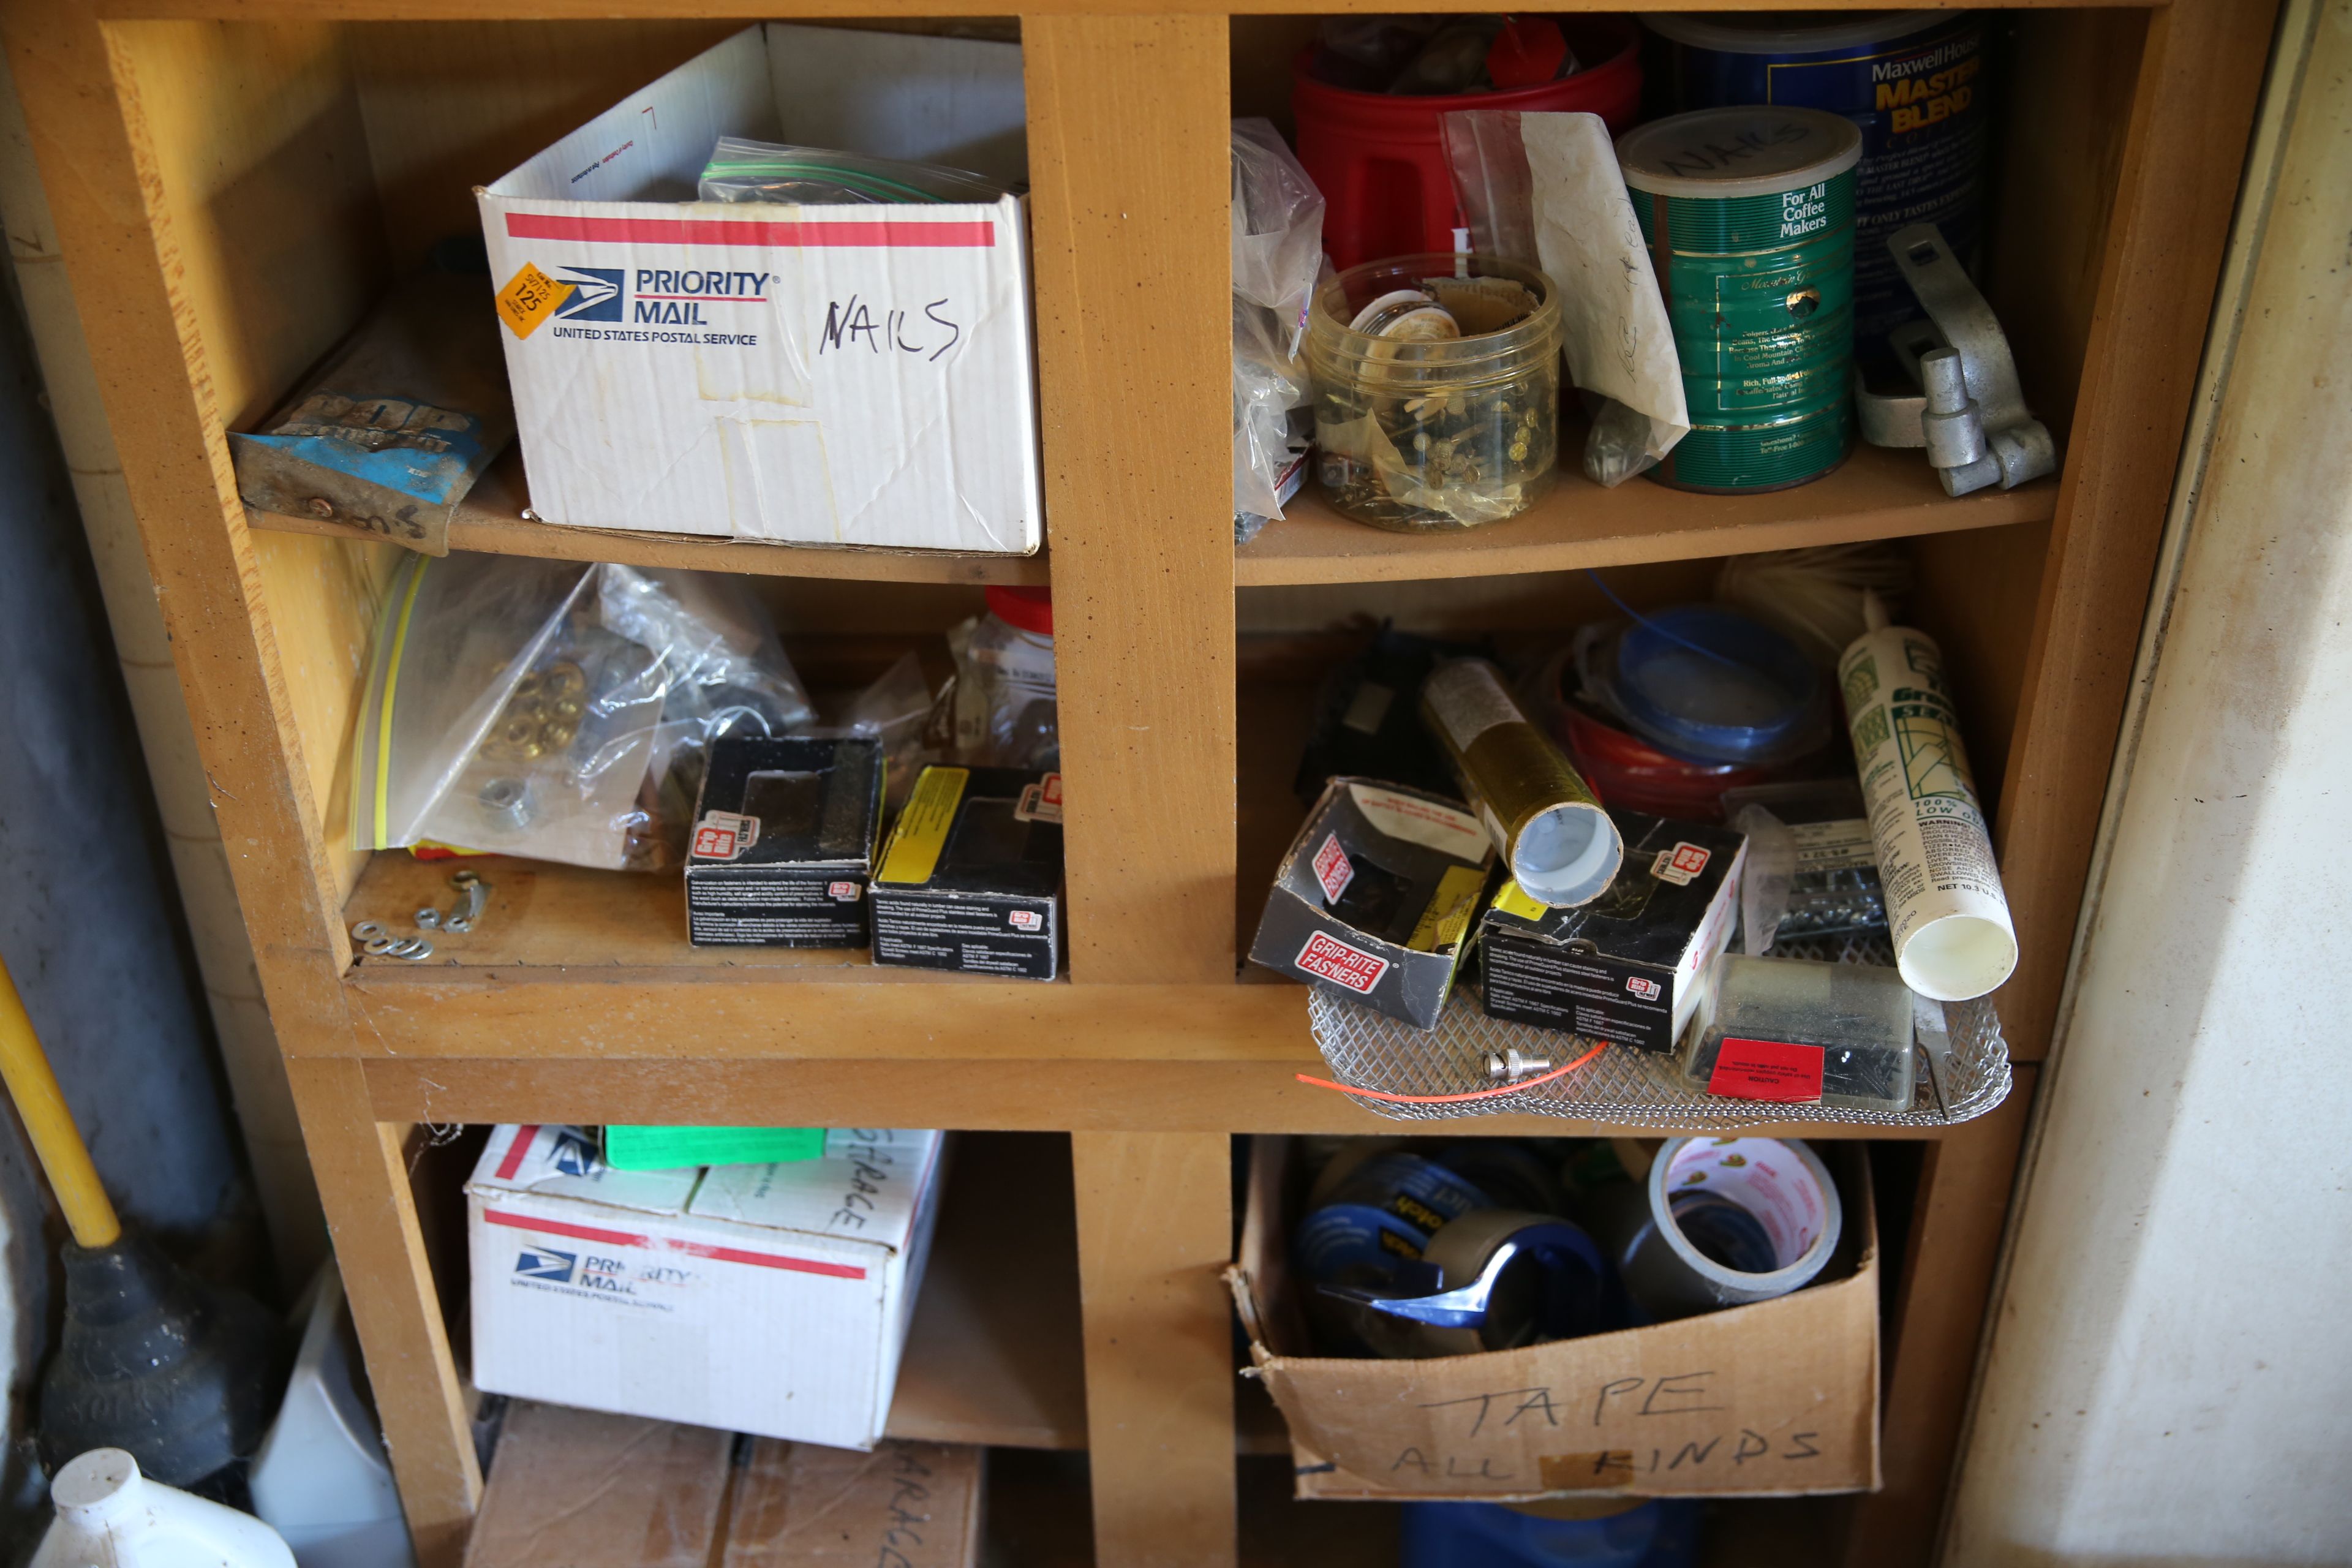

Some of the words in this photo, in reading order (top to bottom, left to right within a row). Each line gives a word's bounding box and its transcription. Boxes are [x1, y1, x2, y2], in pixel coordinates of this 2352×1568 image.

[1872, 47, 1942, 81] Maxwell
[1875, 54, 1980, 111] MASTER
[1891, 86, 1972, 134] BLEND
[1782, 192, 1804, 208] For
[1809, 183, 1825, 199] All
[1783, 201, 1825, 222] Coffee
[1779, 216, 1826, 238] Makers
[516, 283, 542, 311] 125
[635, 270, 769, 296] PRIORITY
[634, 301, 707, 326] MAIL
[818, 293, 960, 361] NAILS
[553, 326, 602, 341] UNITED
[603, 329, 650, 342] STATES
[651, 331, 701, 344] POSTAL
[703, 333, 757, 346] SERVICE
[1915, 799, 1958, 808] 100%
[1917, 807, 1953, 816] LOW
[1311, 937, 1381, 975] GRIP-RITE
[1302, 953, 1370, 989] FAS'NERS
[1418, 1371, 1724, 1437] TAPE
[1392, 1447, 1514, 1482] ALL
